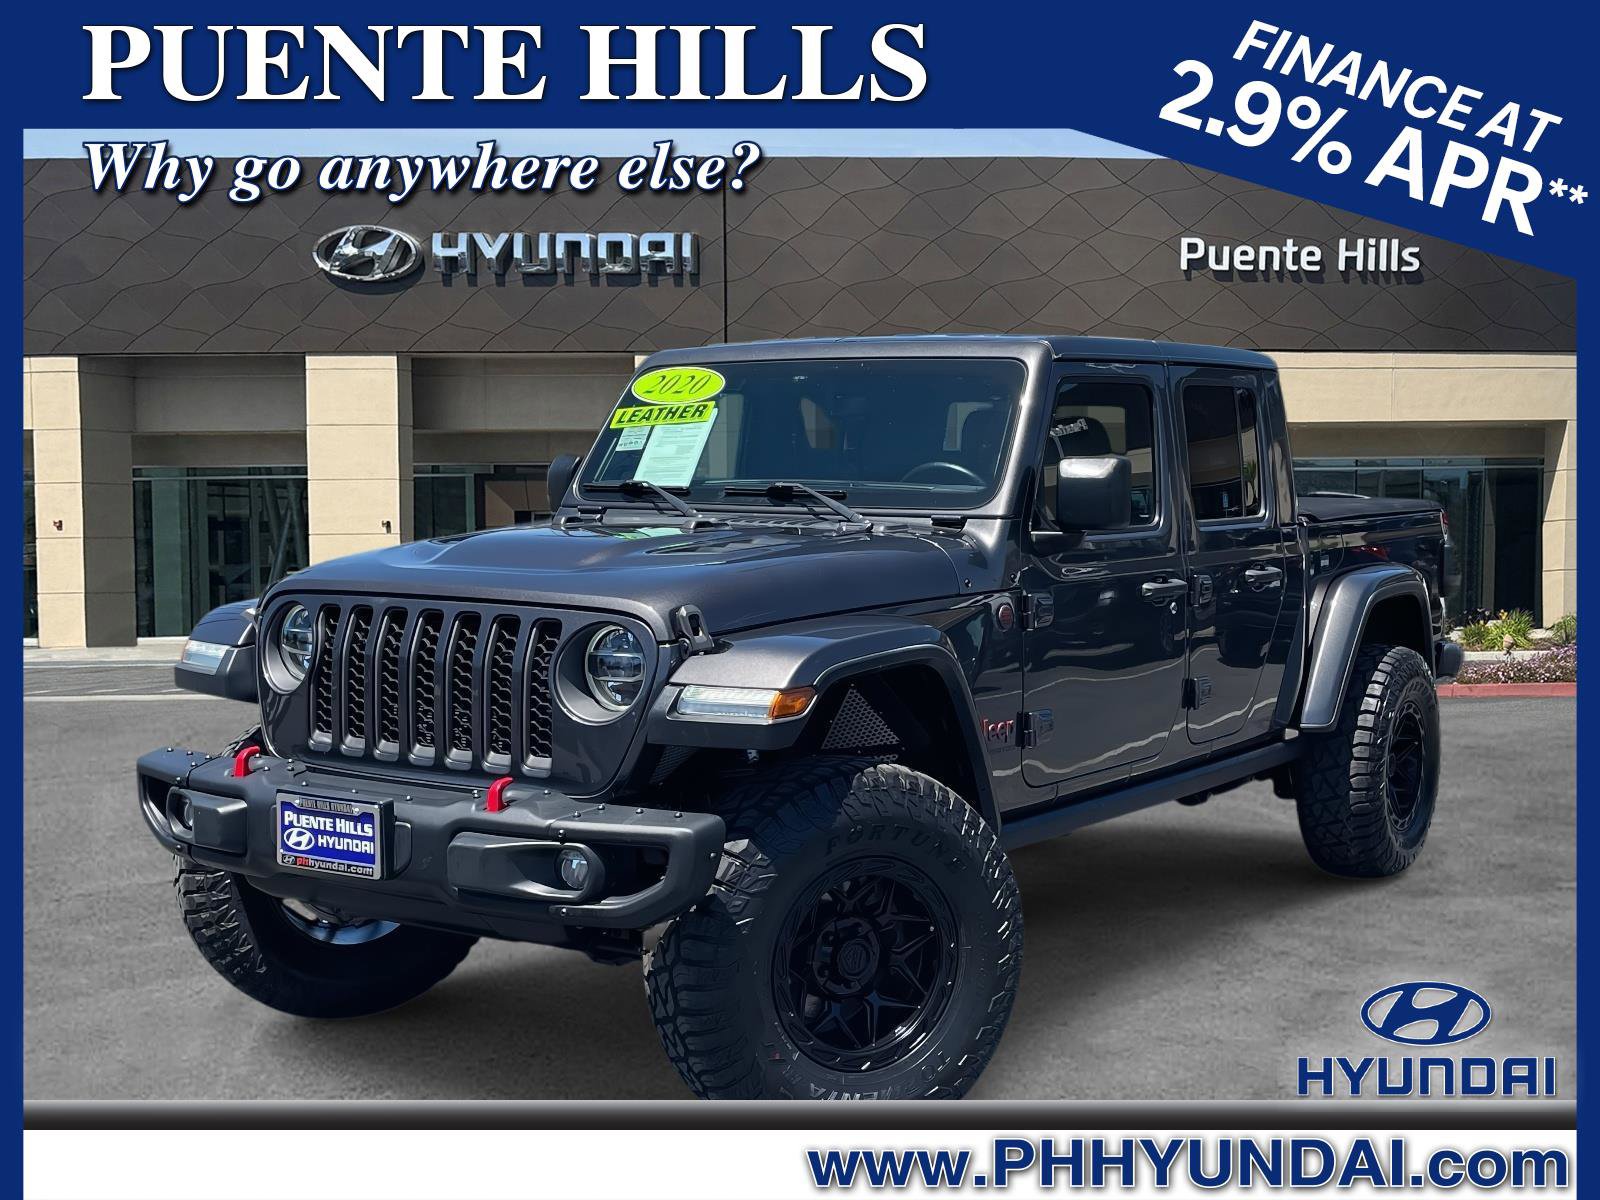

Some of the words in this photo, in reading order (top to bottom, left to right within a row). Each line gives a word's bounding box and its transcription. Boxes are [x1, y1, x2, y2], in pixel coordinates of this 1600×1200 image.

[432, 232, 699, 274] HYUNDAI
[1180, 238, 1322, 272] Puente
[1338, 238, 1420, 272] Hills
[643, 374, 712, 395] 2020
[615, 403, 709, 425] LEATHER
[284, 811, 334, 832] PUENTE
[336, 818, 373, 837] HILLS
[318, 835, 374, 855] HYUNDAI
[296, 856, 373, 876] phhyundai.com
